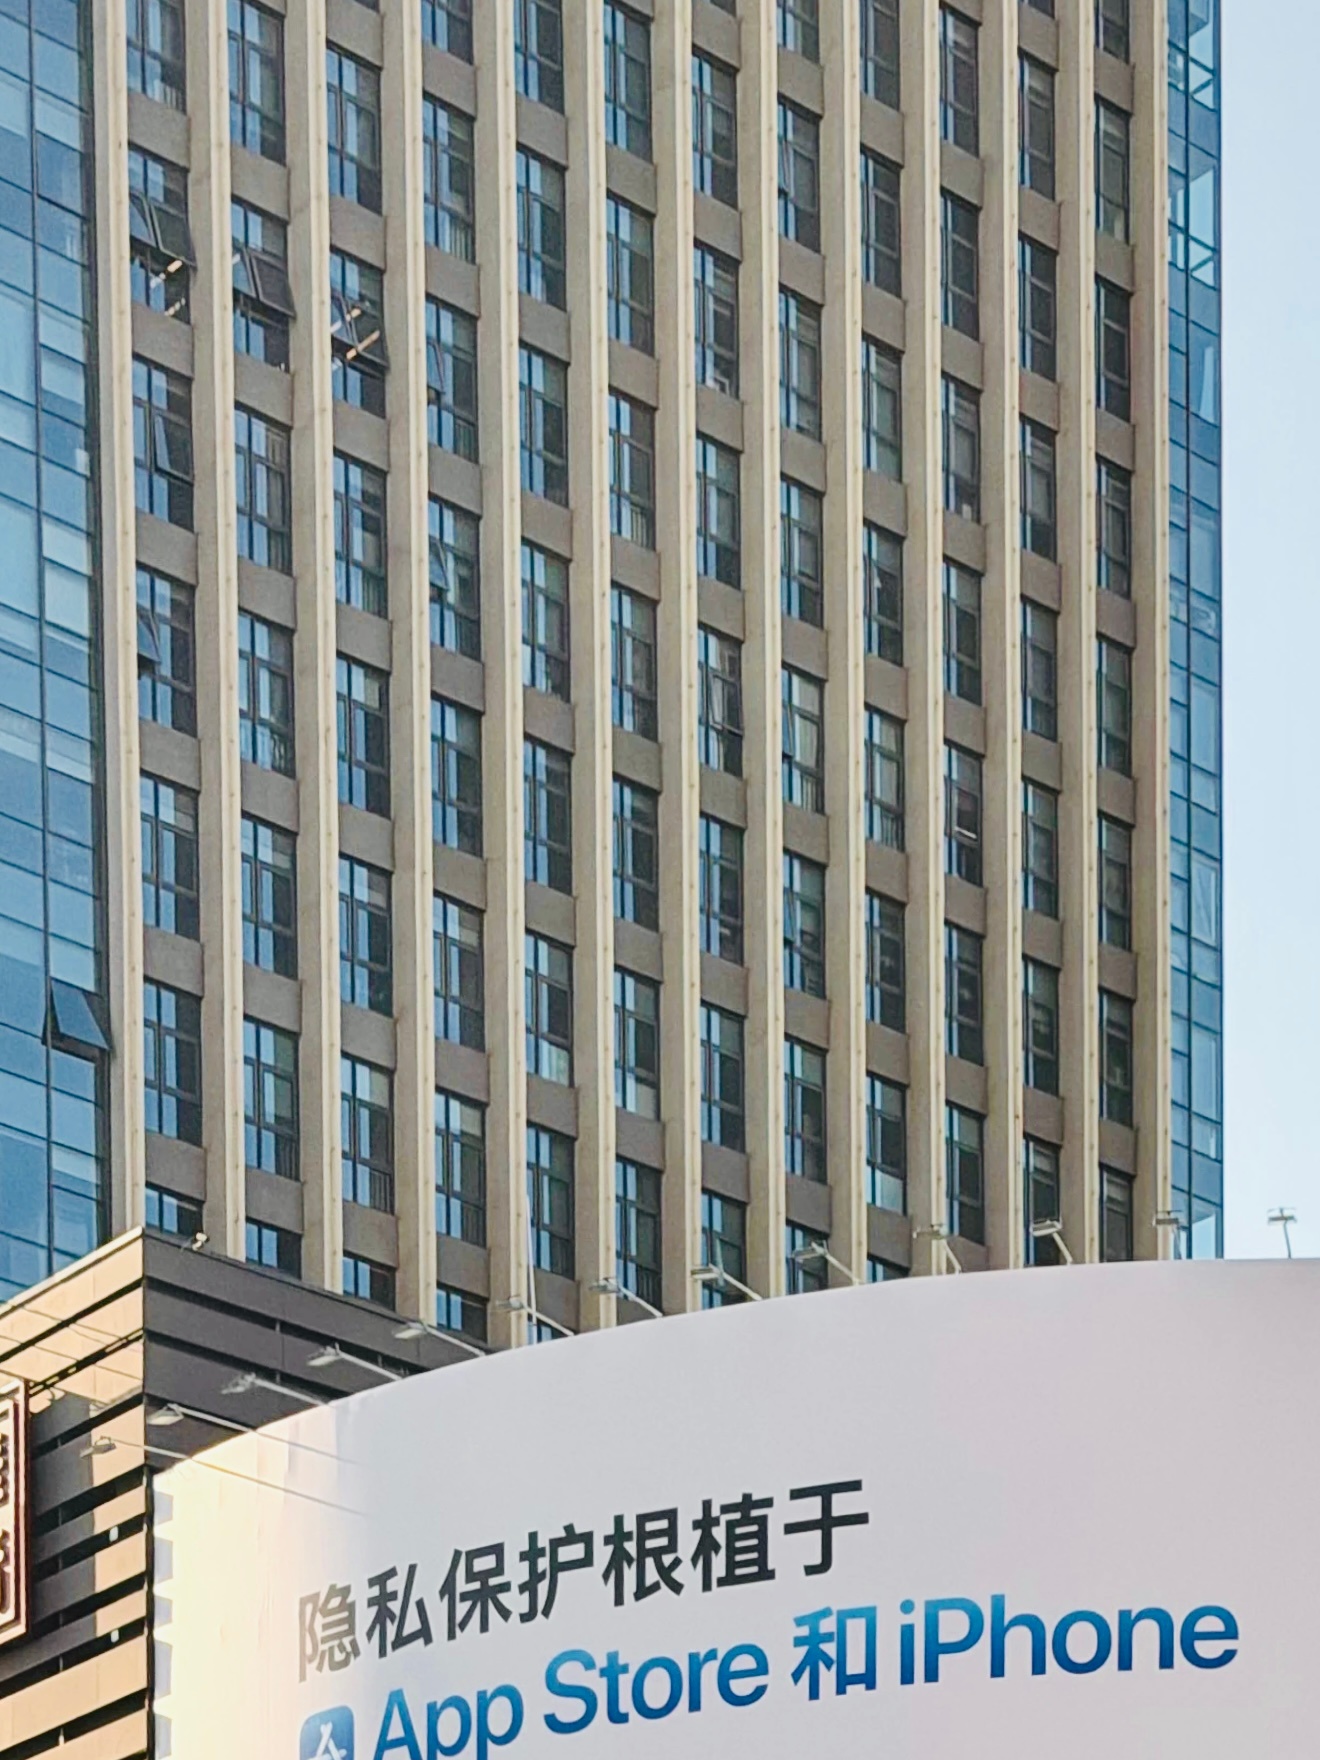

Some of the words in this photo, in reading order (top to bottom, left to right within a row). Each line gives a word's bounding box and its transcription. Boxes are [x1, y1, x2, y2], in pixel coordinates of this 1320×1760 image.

[298, 1479, 870, 1683] 隐私保护根植于
[543, 1641, 770, 1735] Store
[791, 1604, 878, 1701] 和
[900, 1594, 1239, 1686] iPhone
